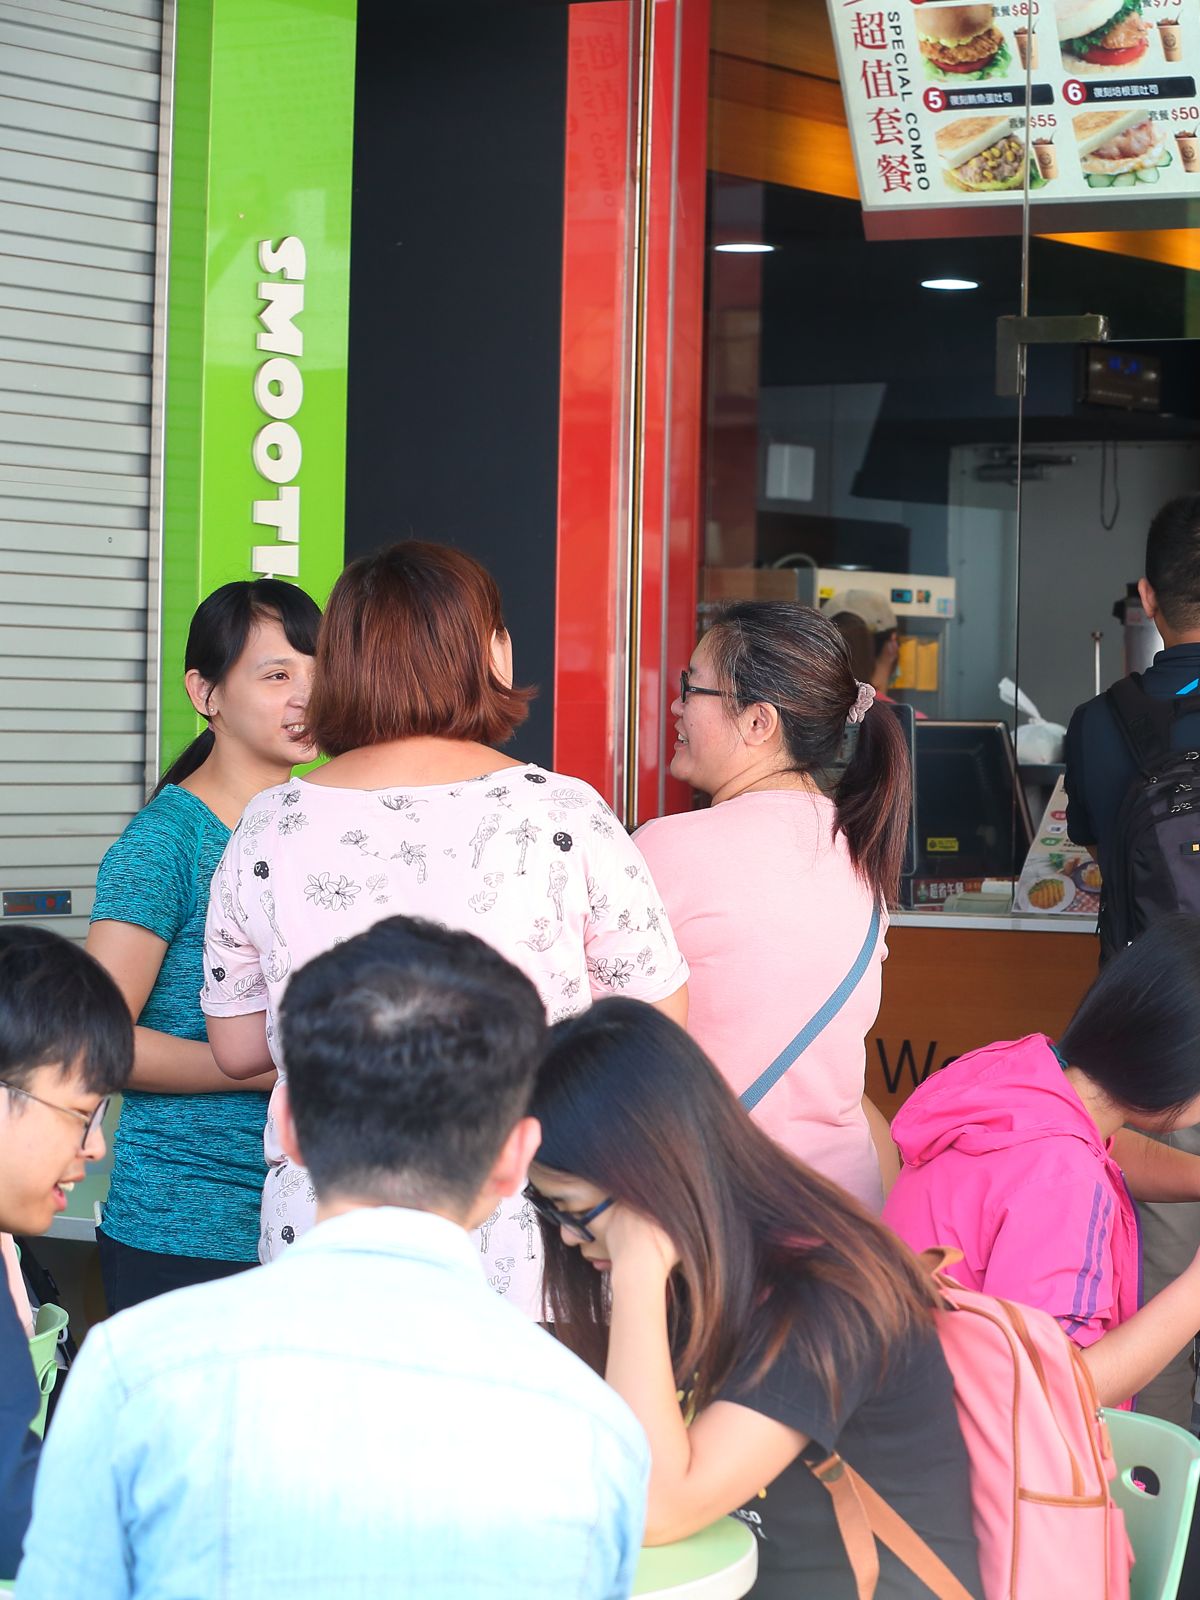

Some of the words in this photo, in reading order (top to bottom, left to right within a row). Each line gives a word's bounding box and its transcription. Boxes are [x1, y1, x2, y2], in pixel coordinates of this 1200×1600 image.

[887, 11, 913, 102] SPECIAL
[905, 112, 931, 191] COMBO
[928, 91, 943, 109] 5
[1067, 83, 1083, 101] 6
[851, 11, 912, 193] 超值套餐
[1029, 114, 1057, 128] $55
[1148, 108, 1169, 122] 套餐
[1171, 106, 1200, 122] $50
